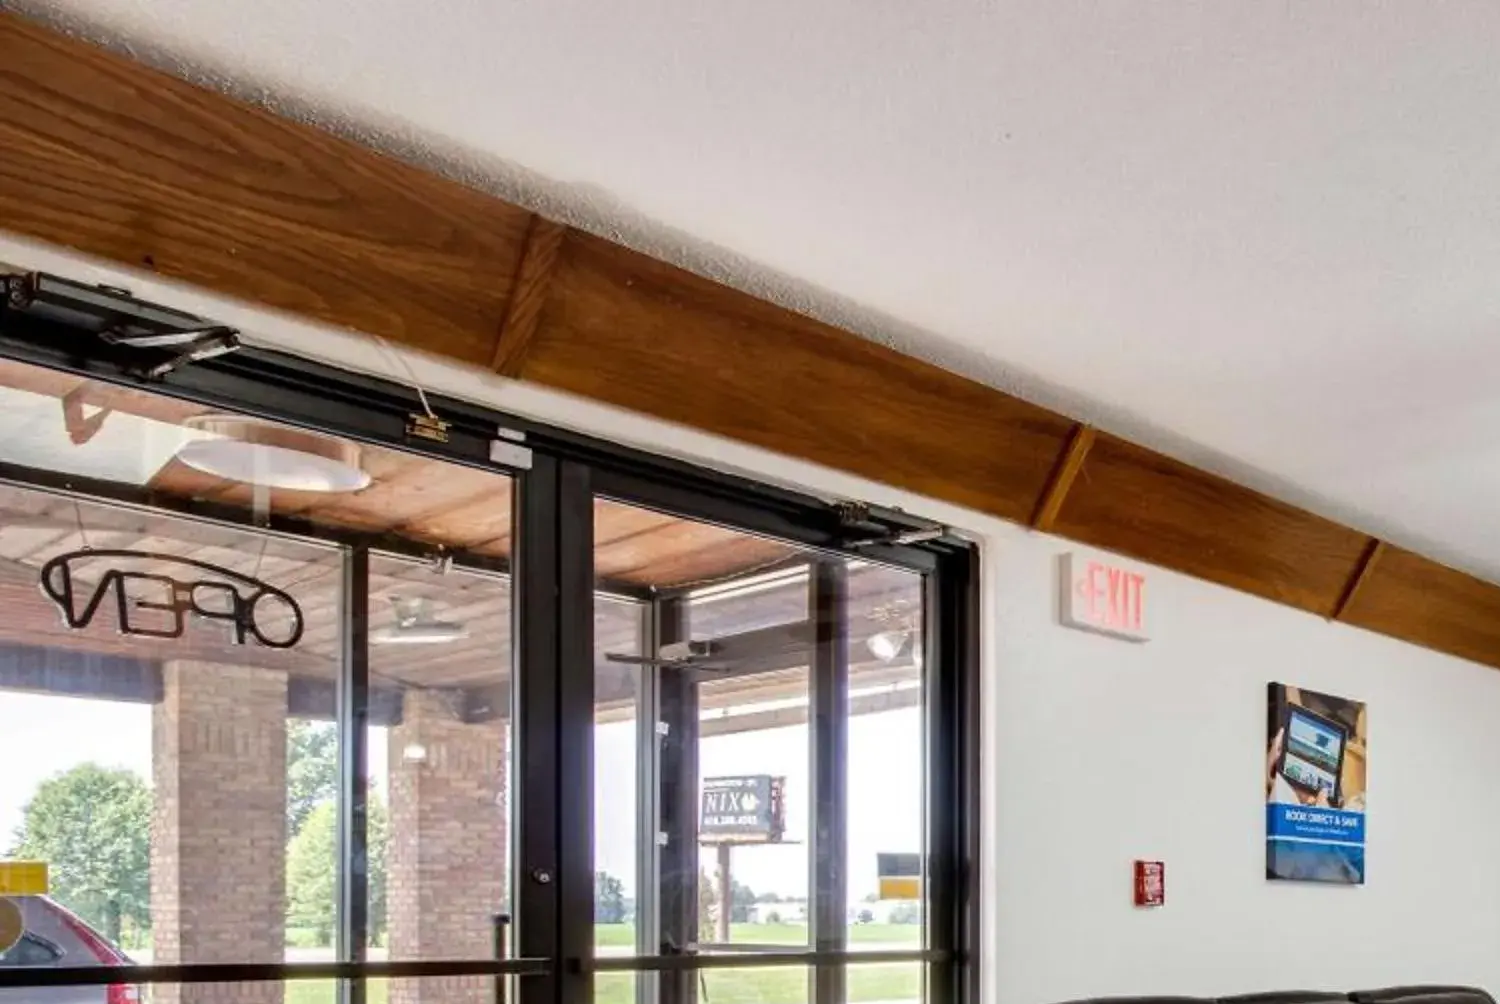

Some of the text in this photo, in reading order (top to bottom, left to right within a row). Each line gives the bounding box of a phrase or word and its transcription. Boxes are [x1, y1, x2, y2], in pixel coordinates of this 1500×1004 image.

[1086, 561, 1145, 630] EXIT
[1285, 809, 1307, 821] BOOK
[1307, 812, 1334, 824] DIRECT
[1342, 816, 1358, 828] SAVE
